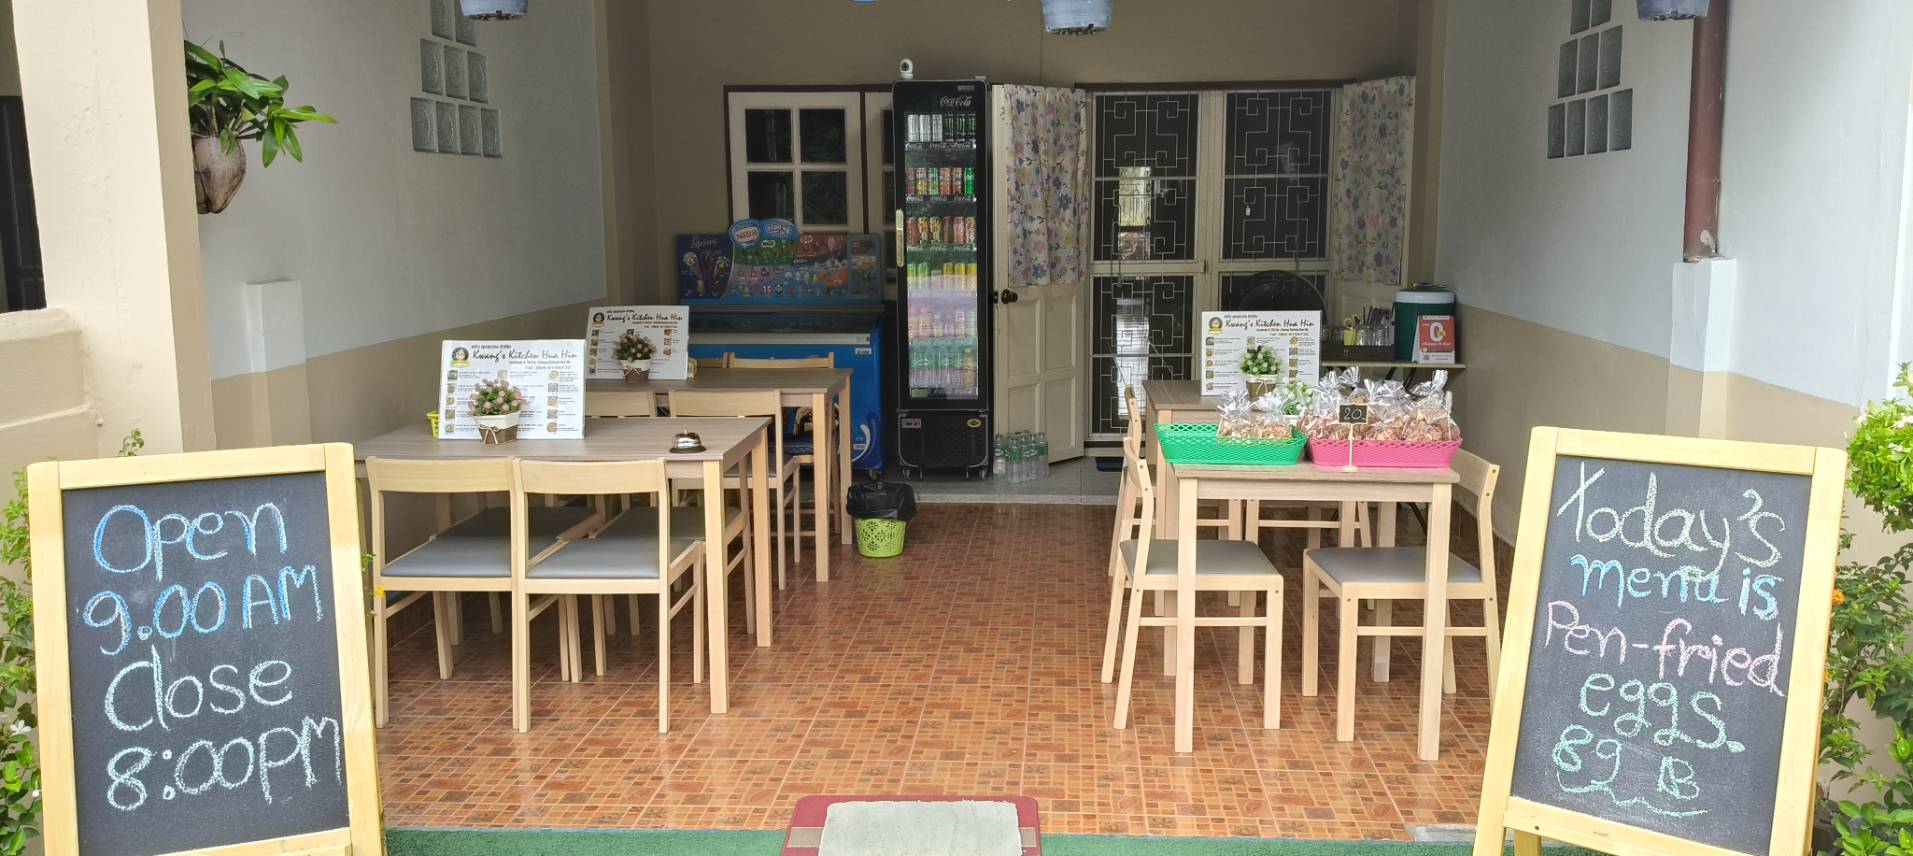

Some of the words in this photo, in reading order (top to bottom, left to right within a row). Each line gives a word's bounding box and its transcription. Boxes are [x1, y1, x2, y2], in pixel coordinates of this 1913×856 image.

[472, 350, 506, 363] Kwang's
[508, 350, 539, 359] Kitchen
[542, 350, 559, 359] Hua
[561, 350, 577, 359] Hin
[1225, 320, 1254, 330] Kwang's
[1255, 319, 1281, 327] Kitchen
[93, 502, 287, 582] Open
[1556, 461, 1786, 581] Today's
[82, 580, 228, 656] 9.00
[242, 564, 324, 632] AM
[1570, 553, 1729, 608] menu
[1738, 567, 1784, 621] is
[104, 644, 294, 732] Close
[1544, 600, 1786, 697] Pen-fried
